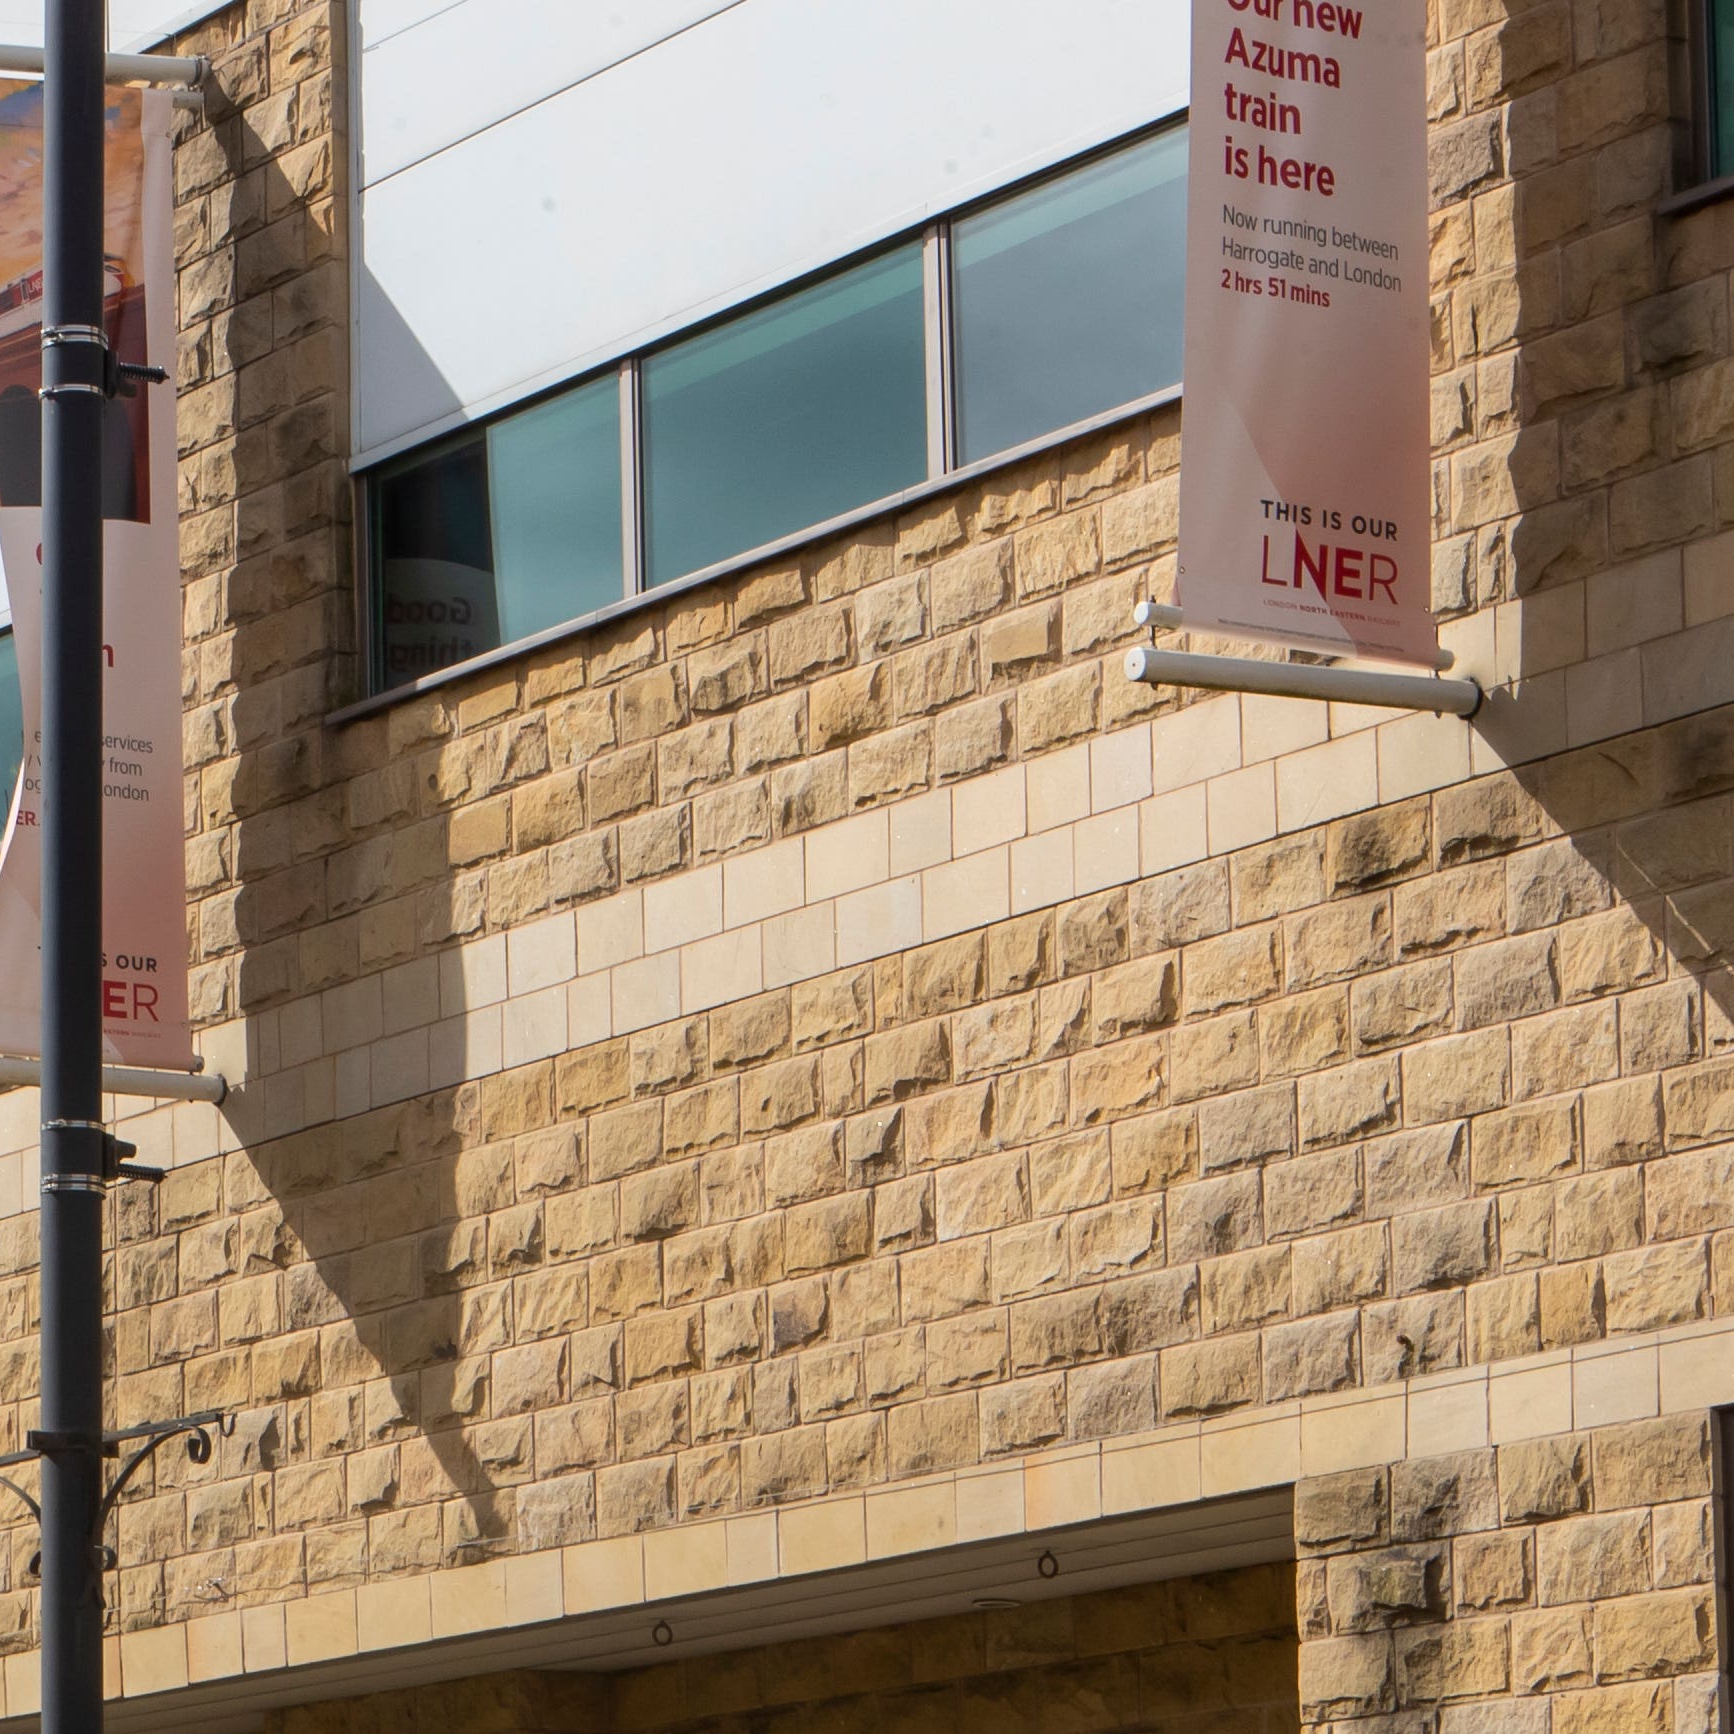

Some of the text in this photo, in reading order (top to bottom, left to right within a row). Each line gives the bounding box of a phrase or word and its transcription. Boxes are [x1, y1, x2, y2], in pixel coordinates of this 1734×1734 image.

[1228, 0, 1363, 39] ur new
[1225, 27, 1340, 88] Azuma
[1225, 83, 1301, 134] train
[1225, 136, 1335, 196] is here
[1223, 204, 1399, 260] Now running between
[1222, 236, 1401, 292] Harrogate and London
[1221, 268, 1330, 308] 2 hrs 51 mins
[1260, 499, 1398, 541] THIS IS OUR
[1261, 529, 1398, 605] LNER
[1299, 604, 1328, 615] NORTH
[1329, 609, 1366, 621] EASTERN
[109, 757, 143, 777] from
[102, 781, 150, 801] ondon
[116, 954, 157, 972] OUR
